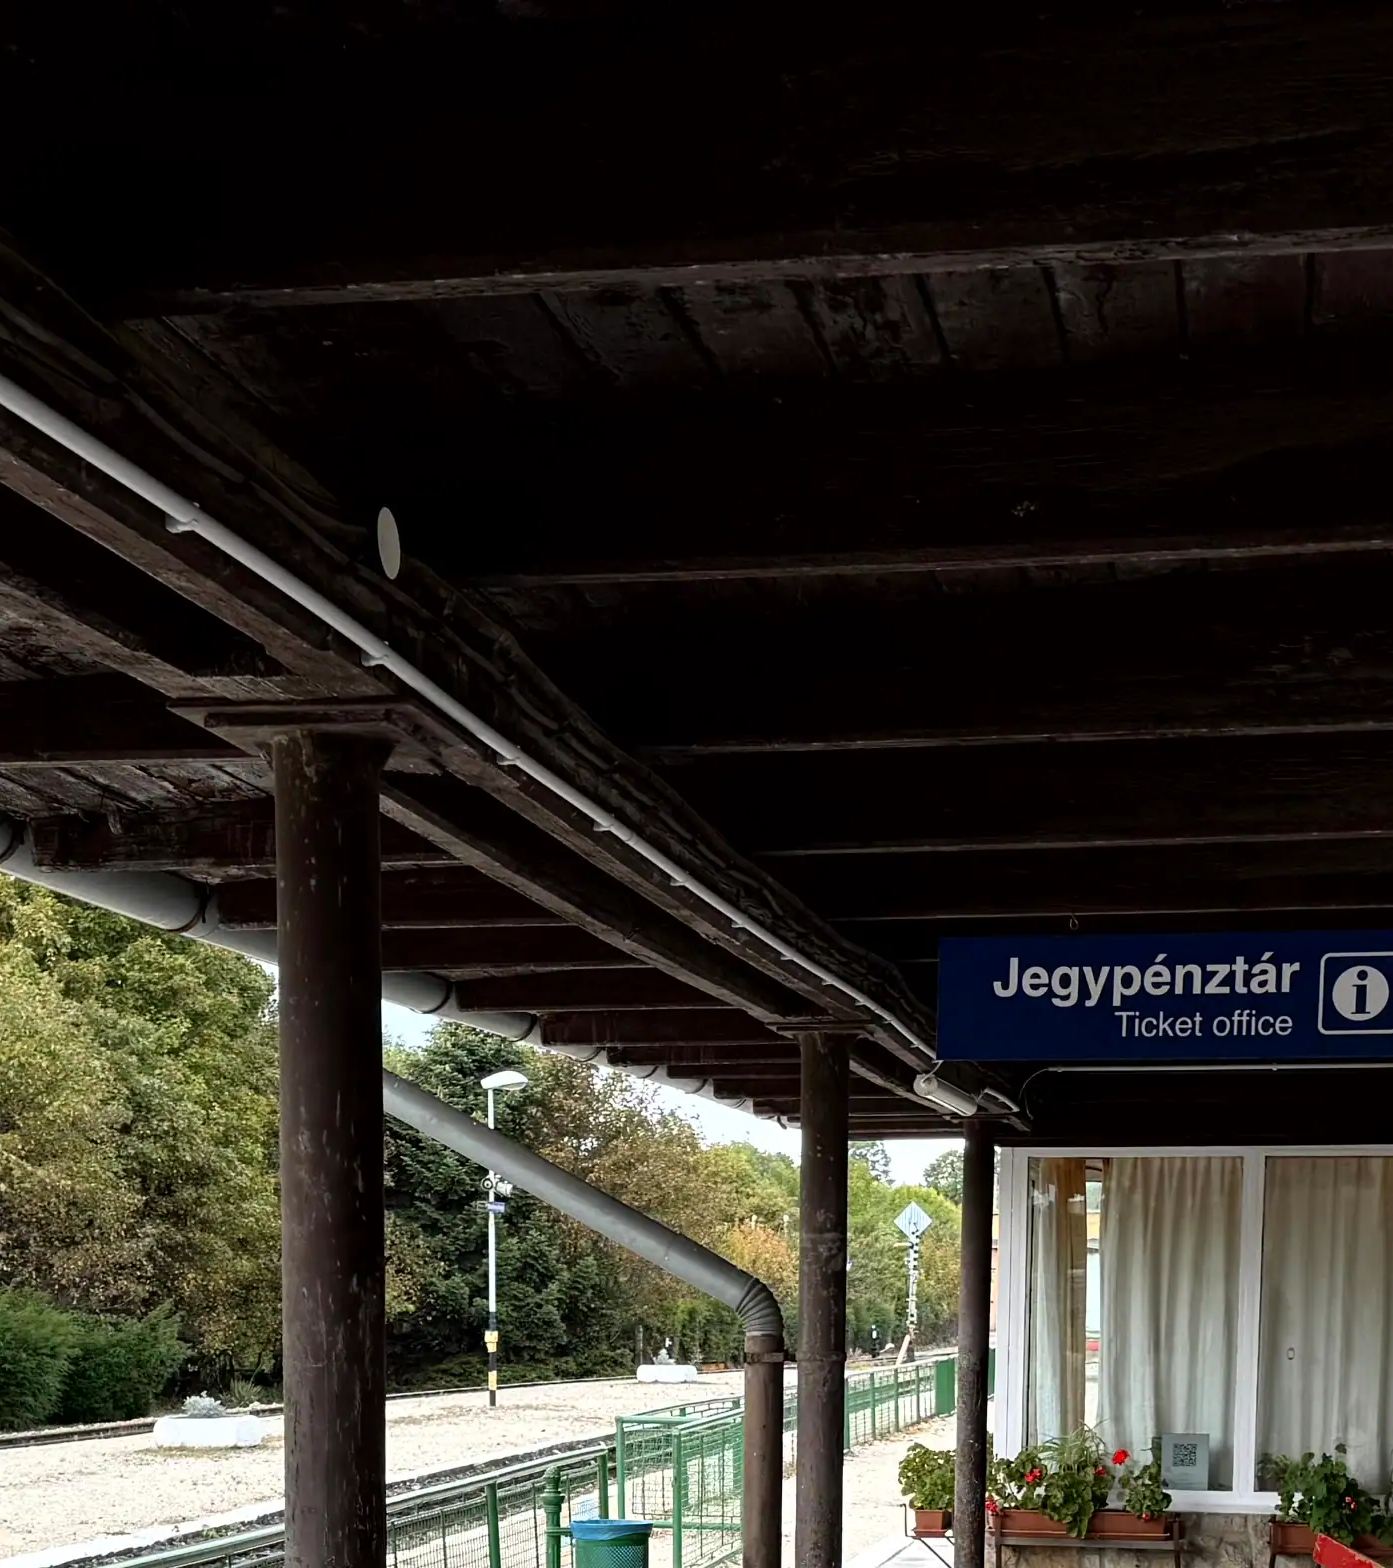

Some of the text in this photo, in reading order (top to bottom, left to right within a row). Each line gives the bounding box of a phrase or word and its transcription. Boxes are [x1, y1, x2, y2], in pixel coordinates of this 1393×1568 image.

[993, 952, 1300, 1007] Jegypénztár
[1114, 1009, 1293, 1037] Ticket office
